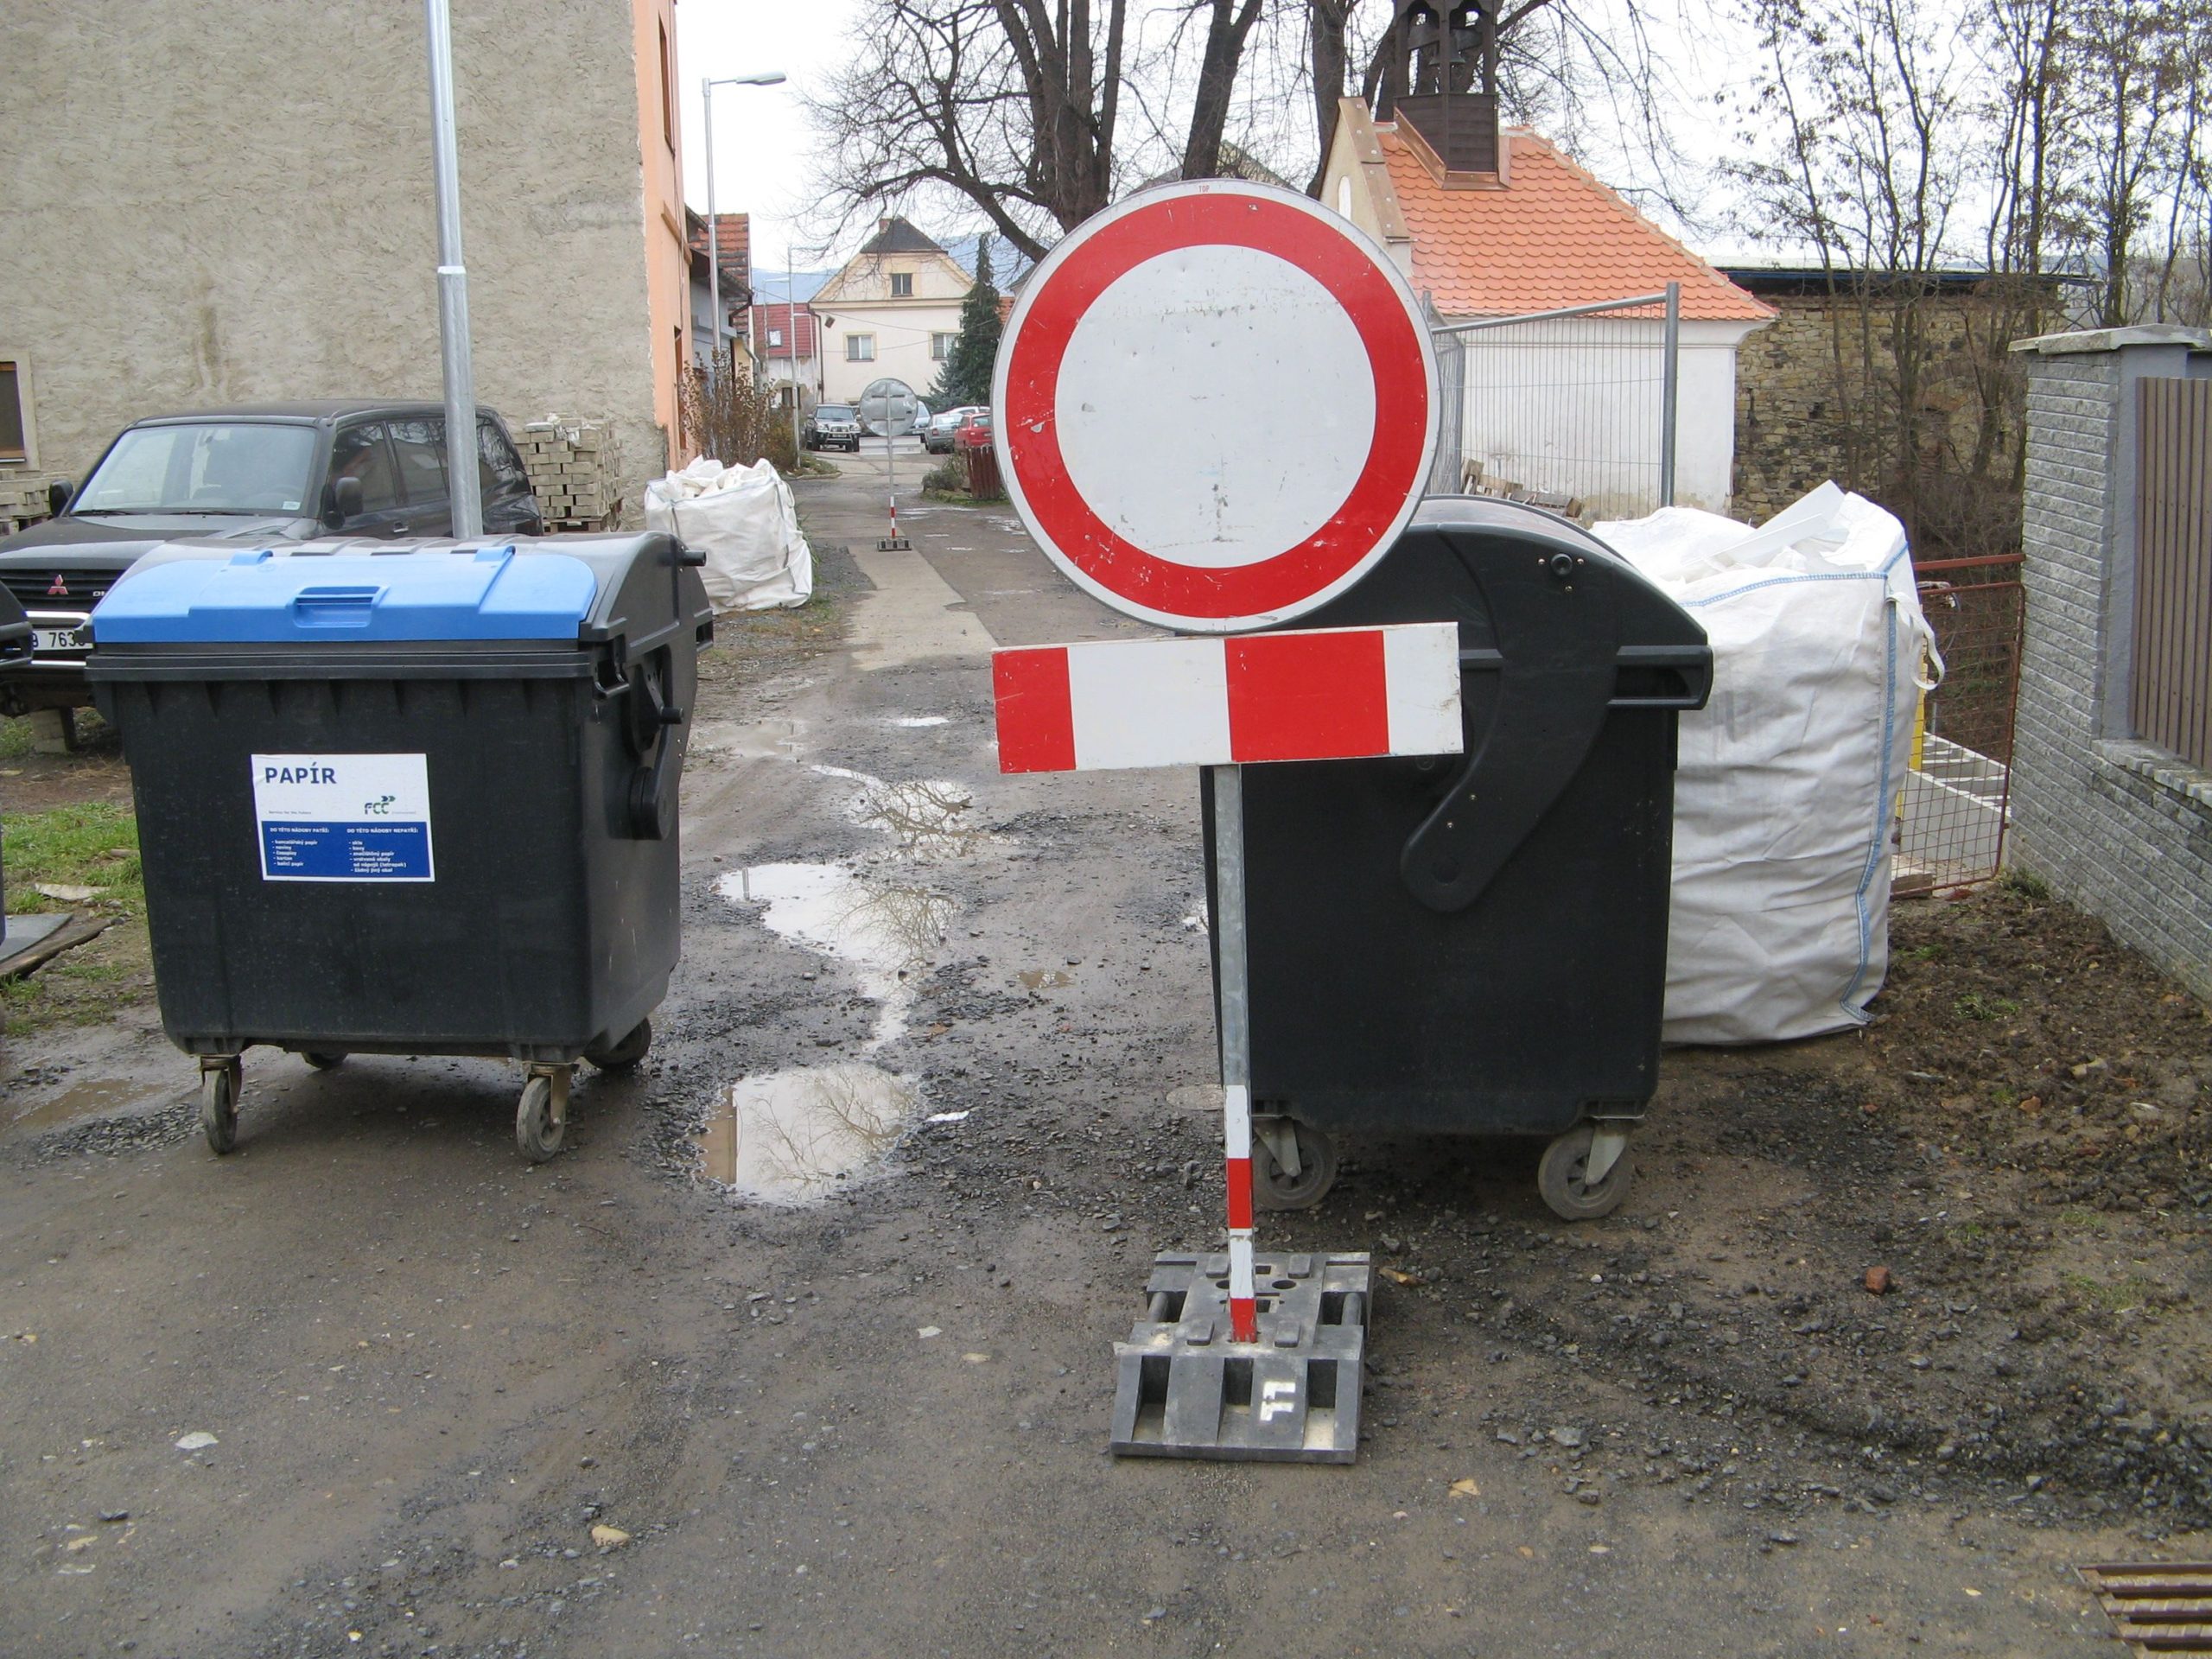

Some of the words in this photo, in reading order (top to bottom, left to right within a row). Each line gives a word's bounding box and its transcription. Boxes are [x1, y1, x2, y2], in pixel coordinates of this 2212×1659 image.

[48, 632, 85, 648] 763
[264, 761, 337, 785] PAPÍR
[364, 802, 390, 815] FCC
